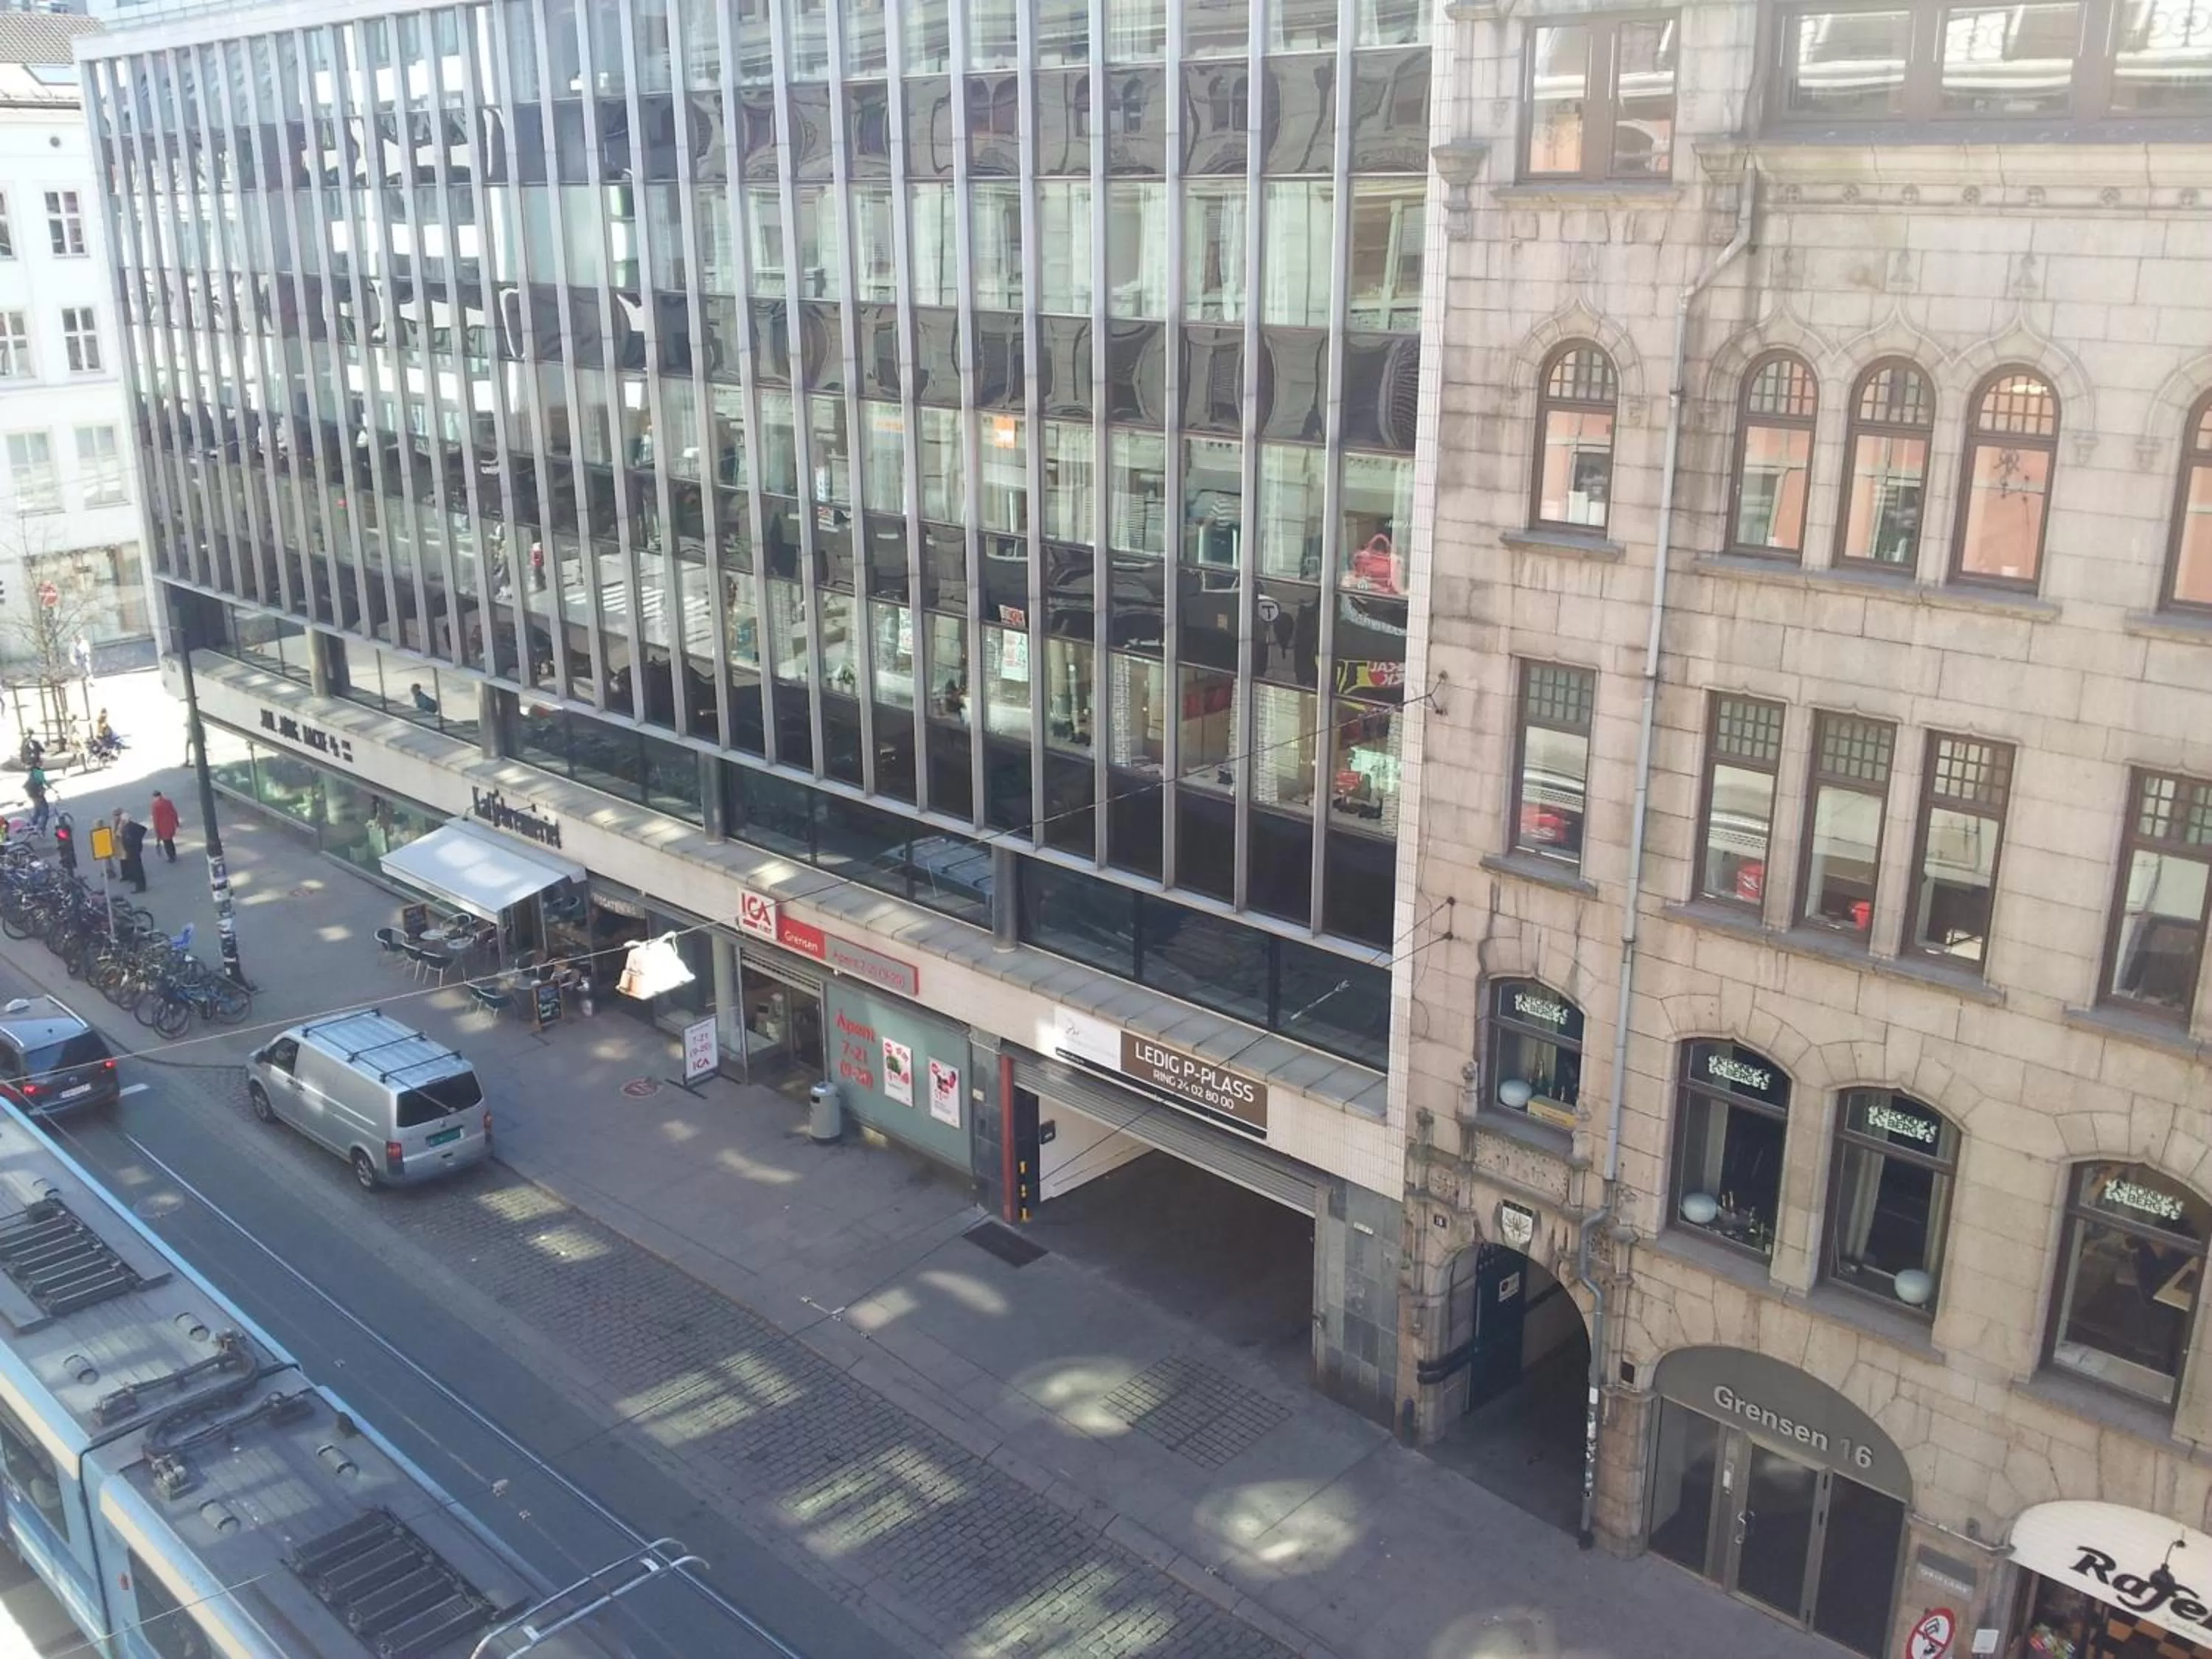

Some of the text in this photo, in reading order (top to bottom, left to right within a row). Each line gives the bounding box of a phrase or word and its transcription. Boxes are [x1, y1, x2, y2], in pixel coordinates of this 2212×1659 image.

[741, 892, 771, 925] ICA
[784, 930, 818, 952] Grensen
[1135, 1040, 1254, 1103] LEDIG P-PLASS
[1152, 1068, 1234, 1110] RING 24 02 80 00
[1713, 1385, 1874, 1469] Grensen 16
[2069, 1545, 2212, 1630] Rafe
